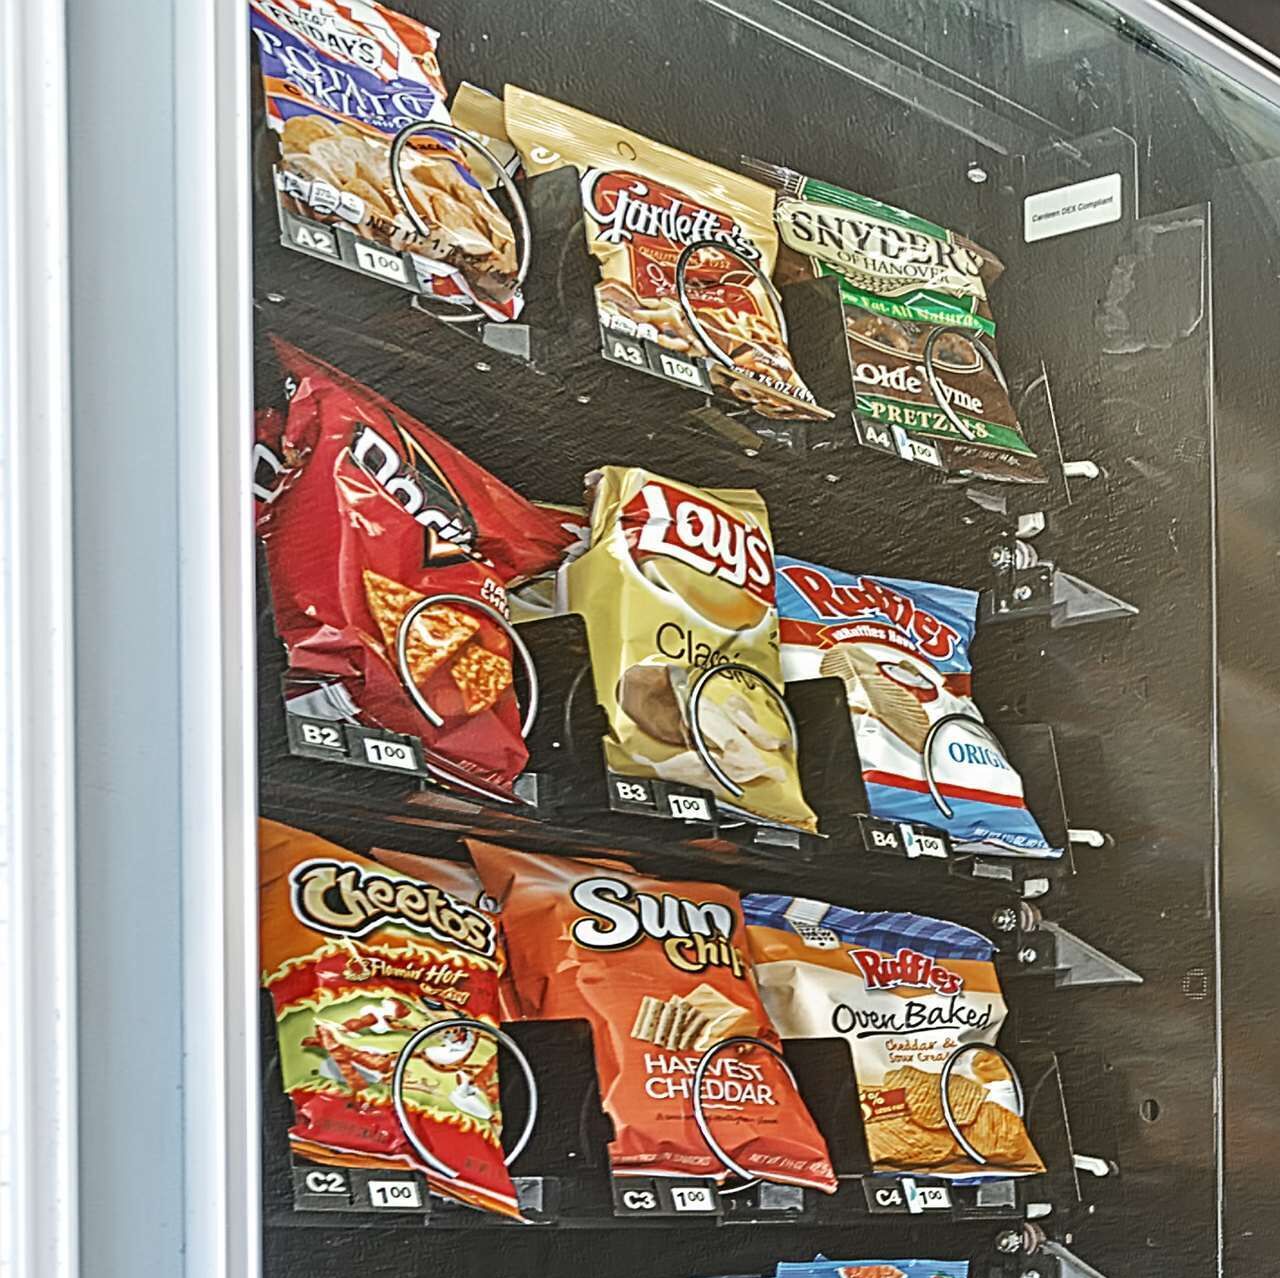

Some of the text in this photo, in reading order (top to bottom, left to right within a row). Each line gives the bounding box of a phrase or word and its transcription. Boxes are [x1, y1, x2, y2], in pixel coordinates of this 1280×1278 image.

[296, 227, 334, 254] A2
[613, 342, 642, 365] A3
[854, 363, 922, 393] Olde
[866, 426, 891, 448] A4
[637, 484, 770, 590] Lay's
[780, 566, 961, 661] Ruffles
[302, 724, 342, 748] B2
[616, 782, 648, 801] B3
[871, 830, 897, 849] B4
[301, 866, 491, 952] Cheetos
[572, 876, 734, 952] Sun
[849, 949, 963, 996] Ruffles
[833, 996, 993, 1033] Oven Baked
[644, 1053, 764, 1081] HARVEST
[645, 1077, 777, 1106] CHEDDAR
[306, 1172, 346, 1193] C2
[624, 1191, 657, 1210] C3
[876, 1191, 901, 1207] C4
